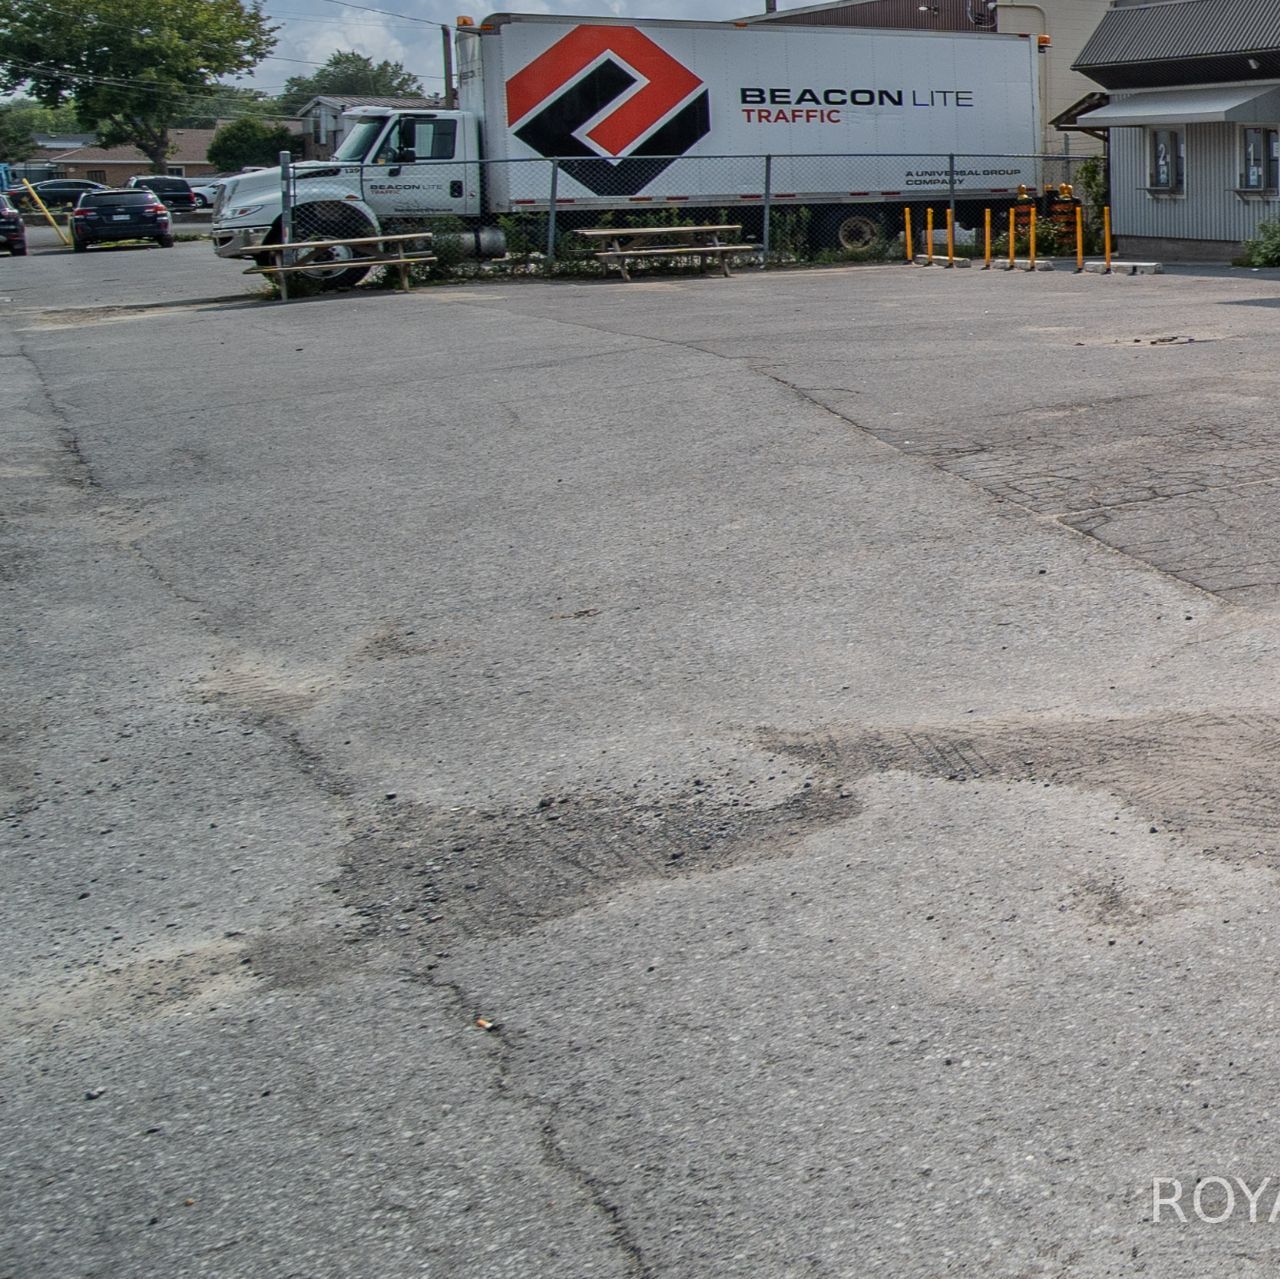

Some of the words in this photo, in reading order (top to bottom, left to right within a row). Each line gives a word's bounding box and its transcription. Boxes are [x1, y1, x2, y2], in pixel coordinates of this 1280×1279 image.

[740, 88, 902, 106] BEACON
[912, 90, 974, 107] LITE
[742, 109, 841, 123] TRAFFIC
[1159, 144, 1166, 165] 2
[1248, 143, 1254, 166] 1
